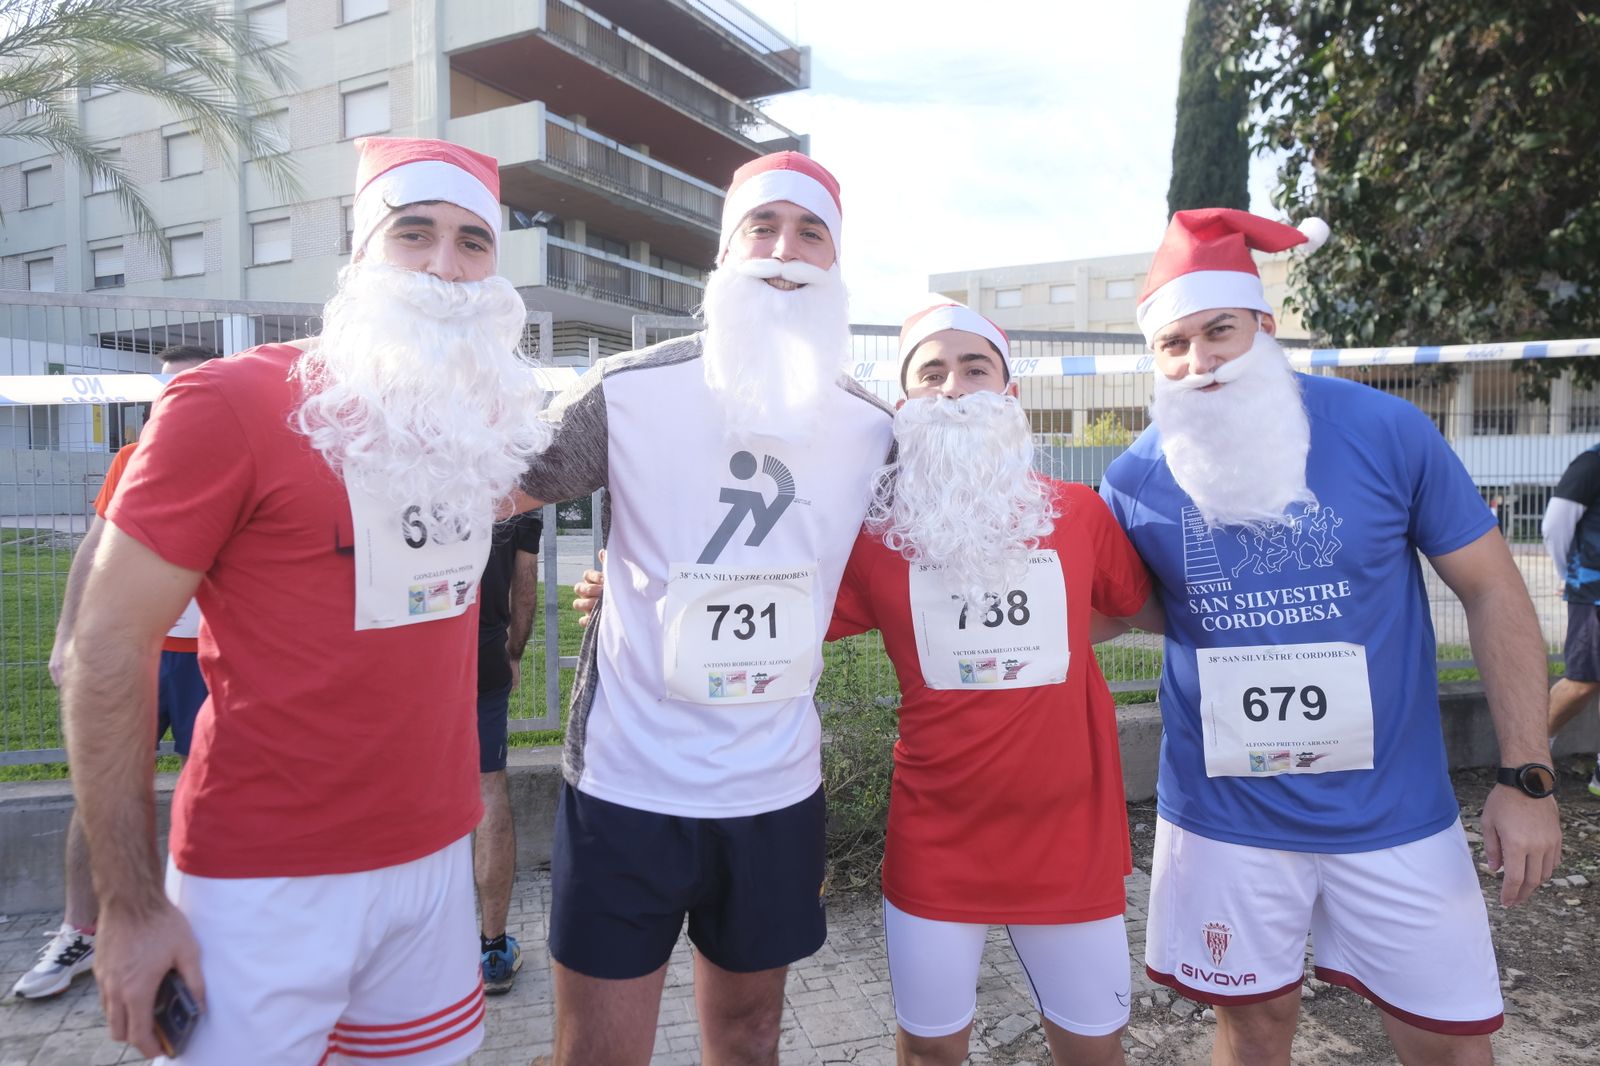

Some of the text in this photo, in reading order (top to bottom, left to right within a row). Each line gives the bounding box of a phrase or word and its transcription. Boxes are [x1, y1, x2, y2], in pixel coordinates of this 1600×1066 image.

[414, 569, 445, 580] GONZALO
[693, 572, 712, 580] SAN
[713, 573, 761, 581] SILVESTRE
[763, 571, 809, 581] CORDOBESA
[1186, 581, 1232, 595] XXXVIII
[1188, 580, 1351, 615] SAN SILVESTRE
[706, 602, 777, 641] 731
[1201, 602, 1343, 632] CORDOBESA
[1222, 655, 1240, 663] SAN
[1242, 651, 1294, 662] SILVESTRE
[1295, 650, 1357, 660] CORDOBESA
[1242, 684, 1328, 722] 679
[1181, 963, 1257, 986] GIVOVA
